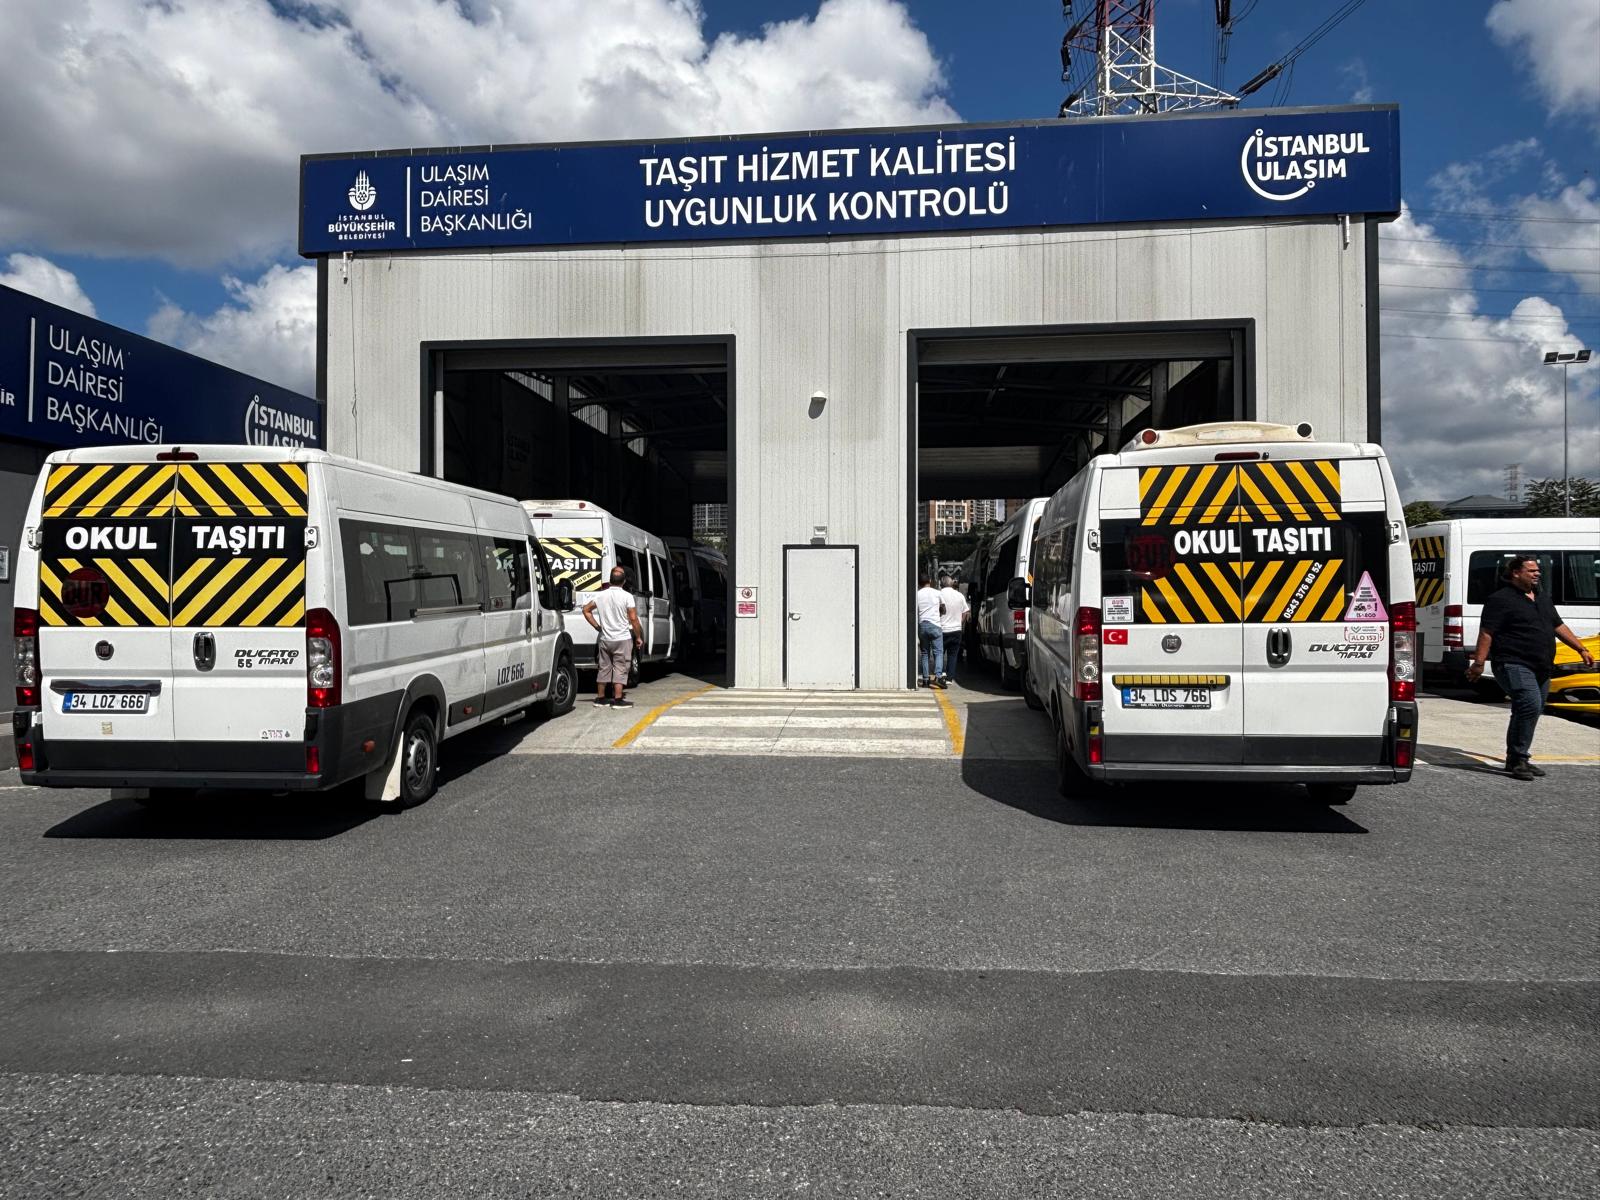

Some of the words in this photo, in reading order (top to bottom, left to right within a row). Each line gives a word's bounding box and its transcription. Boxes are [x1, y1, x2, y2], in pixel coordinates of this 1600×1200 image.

[1256, 128, 1370, 158] İSTANBUL
[421, 164, 490, 186] ULAŞIM
[639, 156, 728, 192] TAŞIT
[738, 146, 860, 182] HİZMET
[870, 135, 1016, 177] KALİTESİ
[1256, 158, 1347, 188] ULAŞIM
[421, 184, 489, 208] DAİRESİ
[645, 194, 818, 228] UYGUNLUK
[829, 181, 1008, 221] KONTROLÜ
[328, 219, 396, 233] BÜYÜKŞEHİR
[338, 213, 385, 221] İSTANBUL
[420, 208, 532, 236] BAŞKANLIĞI
[338, 231, 385, 240] BELEDİYESİ
[49, 324, 124, 370] ULAŞIM
[47, 360, 124, 403] DAİRESİ
[46, 396, 163, 445] BAŞKANLIĞI
[254, 394, 317, 440] İSTANBUL
[65, 526, 157, 550] OKUL
[191, 525, 285, 555] TAŞITI
[1173, 528, 1241, 555] OKUL
[1252, 527, 1332, 555] TAŞITI
[1283, 598, 1300, 619] 0543
[1295, 583, 1309, 599] 376
[1304, 572, 1316, 584] 80
[1311, 561, 1323, 573] 52
[234, 649, 300, 658] DUCATO
[258, 657, 295, 665] MAXI
[1308, 643, 1380, 652] DUCATO
[497, 666, 511, 686] LOZ
[510, 662, 525, 682] 666
[72, 694, 87, 709] 34
[92, 694, 116, 709] LOZ
[120, 694, 145, 709] 666
[1130, 688, 1146, 702] 34
[1153, 688, 1177, 702] LDS
[1182, 688, 1207, 703] 766
